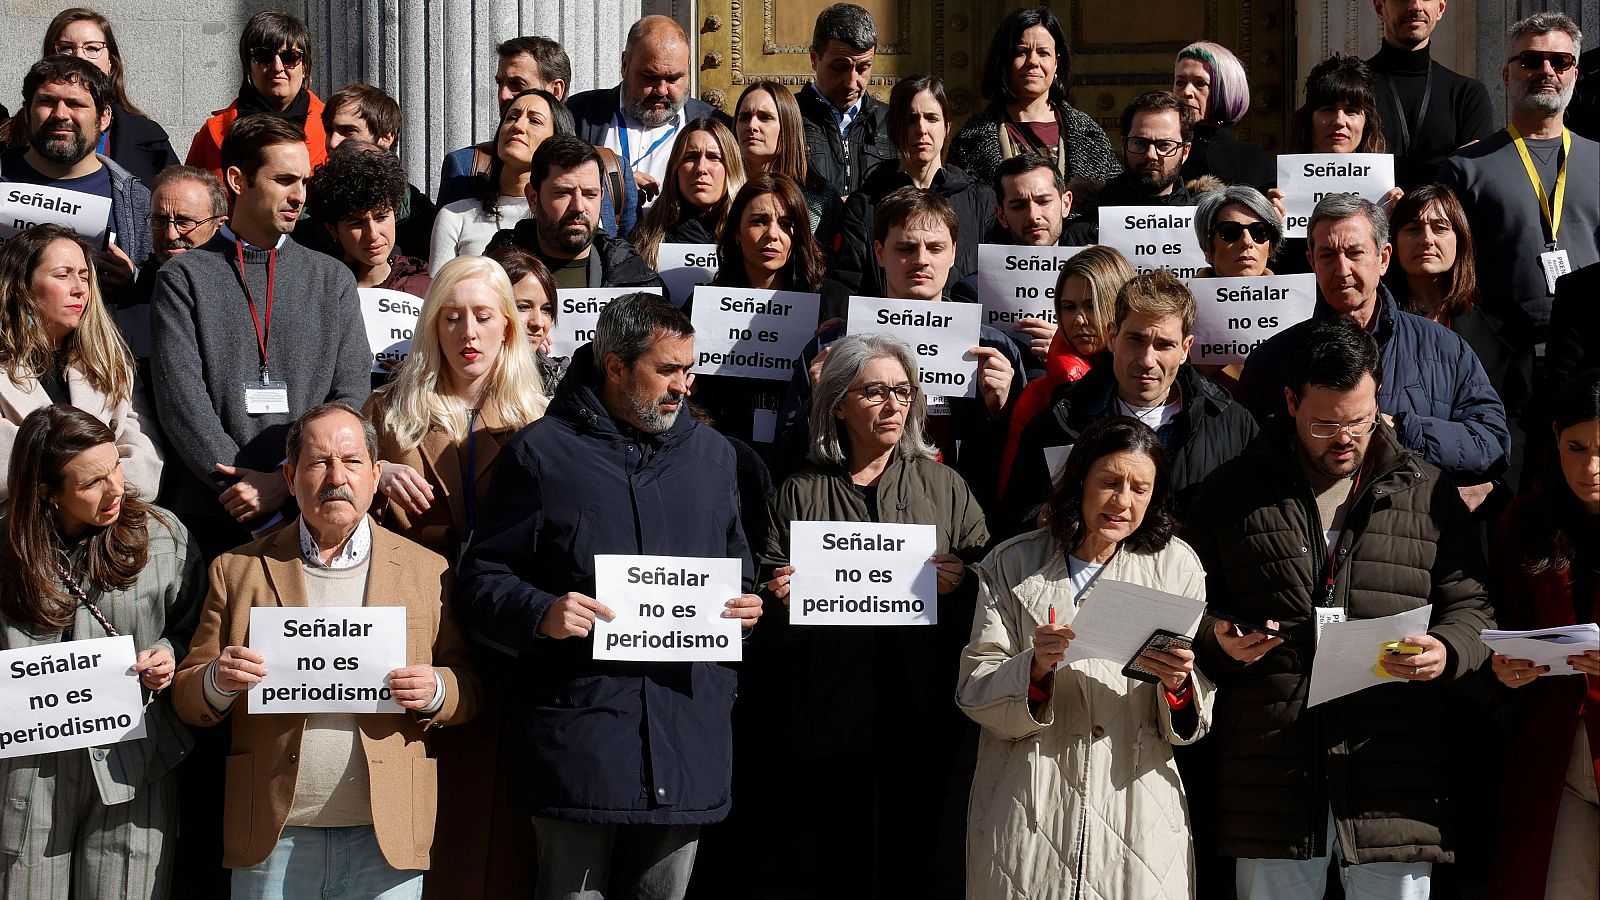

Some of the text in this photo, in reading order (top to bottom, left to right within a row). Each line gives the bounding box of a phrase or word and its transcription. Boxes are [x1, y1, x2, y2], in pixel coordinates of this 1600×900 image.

[1303, 162, 1371, 177] Señalar
[8, 190, 82, 215] Señalar
[1125, 214, 1192, 230] Señalar
[1135, 243, 1182, 255] no es
[1015, 286, 1039, 298] no
[1216, 285, 1290, 303] Señalar
[720, 297, 793, 317] Señalar
[876, 308, 953, 328] Señalar
[1228, 316, 1279, 330] no es
[390, 328, 414, 340] no
[728, 328, 779, 343] no es
[916, 343, 938, 356] es
[822, 532, 906, 552] Señalar
[627, 566, 710, 587] Señalar
[835, 567, 893, 583] no es
[639, 602, 696, 618] no es
[802, 594, 925, 616] periodismo
[283, 618, 373, 638] Señalar
[606, 630, 729, 651] periodismo
[10, 652, 102, 679] Señalar
[297, 656, 359, 671] no es
[29, 688, 93, 710] no es
[262, 683, 392, 705] periodismo
[0, 713, 132, 750] periodismo
